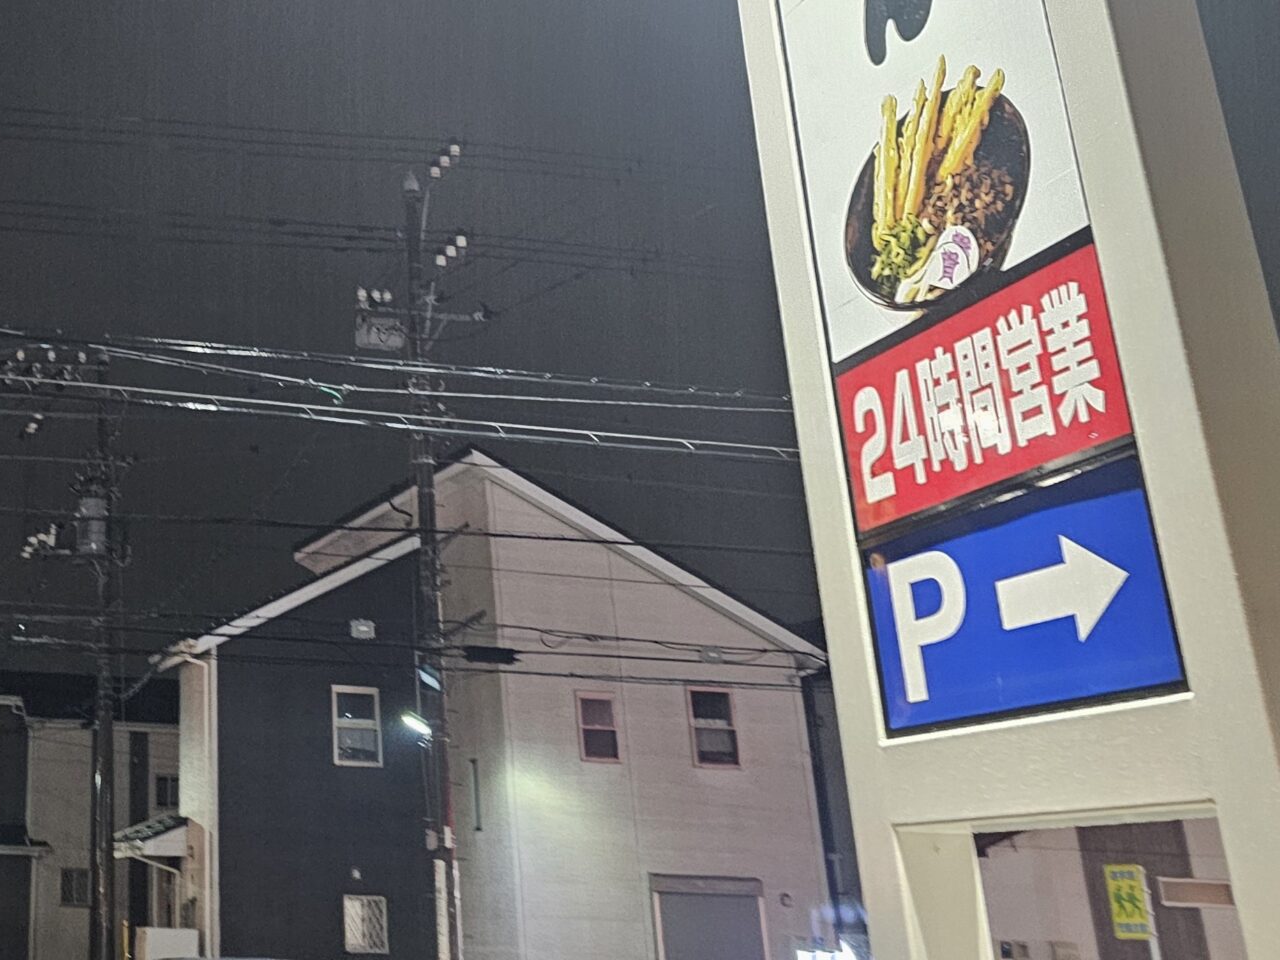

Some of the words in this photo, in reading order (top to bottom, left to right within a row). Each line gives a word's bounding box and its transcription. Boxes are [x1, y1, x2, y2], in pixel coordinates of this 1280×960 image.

[853, 281, 1105, 504] 24時間営業
[887, 550, 966, 703] P
